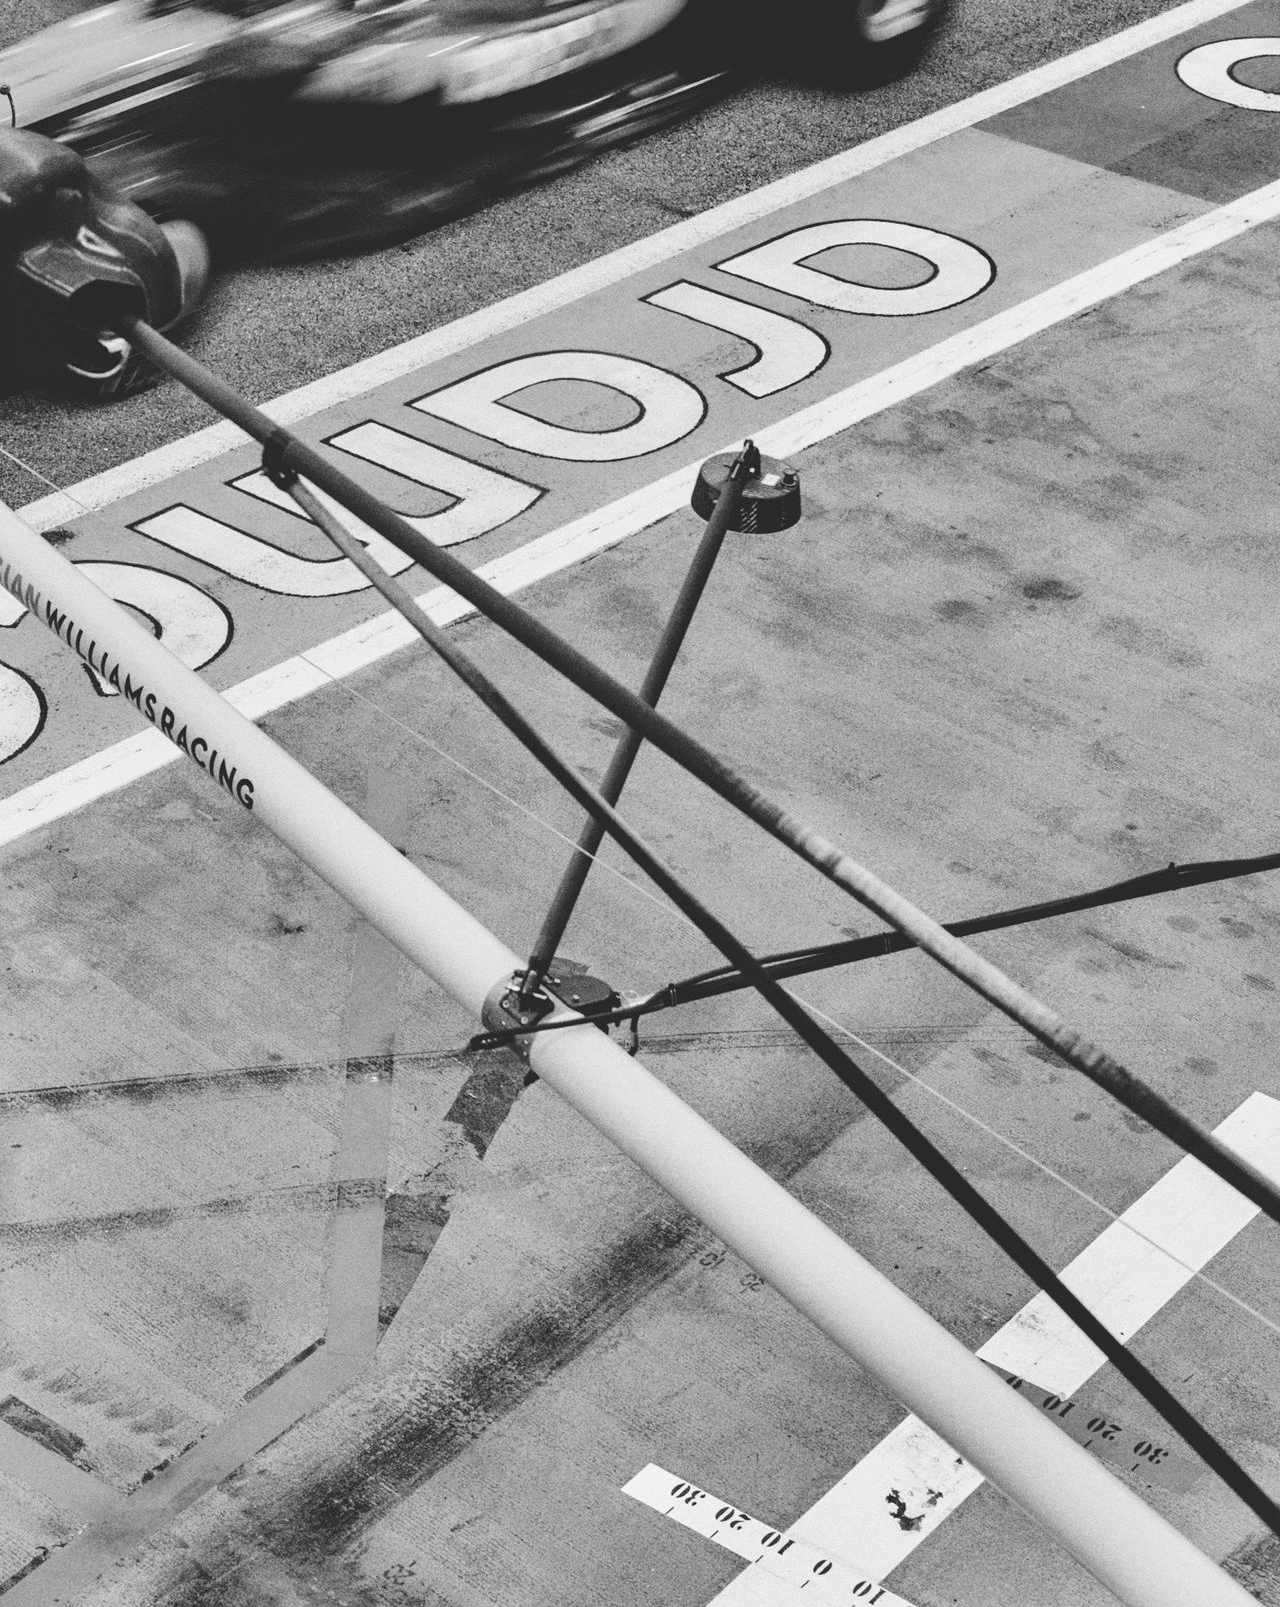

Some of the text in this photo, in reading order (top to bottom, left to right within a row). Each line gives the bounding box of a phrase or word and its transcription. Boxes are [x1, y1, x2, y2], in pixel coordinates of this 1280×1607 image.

[1086, 1417, 1122, 1441] 20
[1133, 1441, 1169, 1465] 30
[670, 1482, 706, 1506] 30
[715, 1506, 752, 1531] 20
[760, 1531, 796, 1555] 10
[852, 1580, 887, 1605] 10
